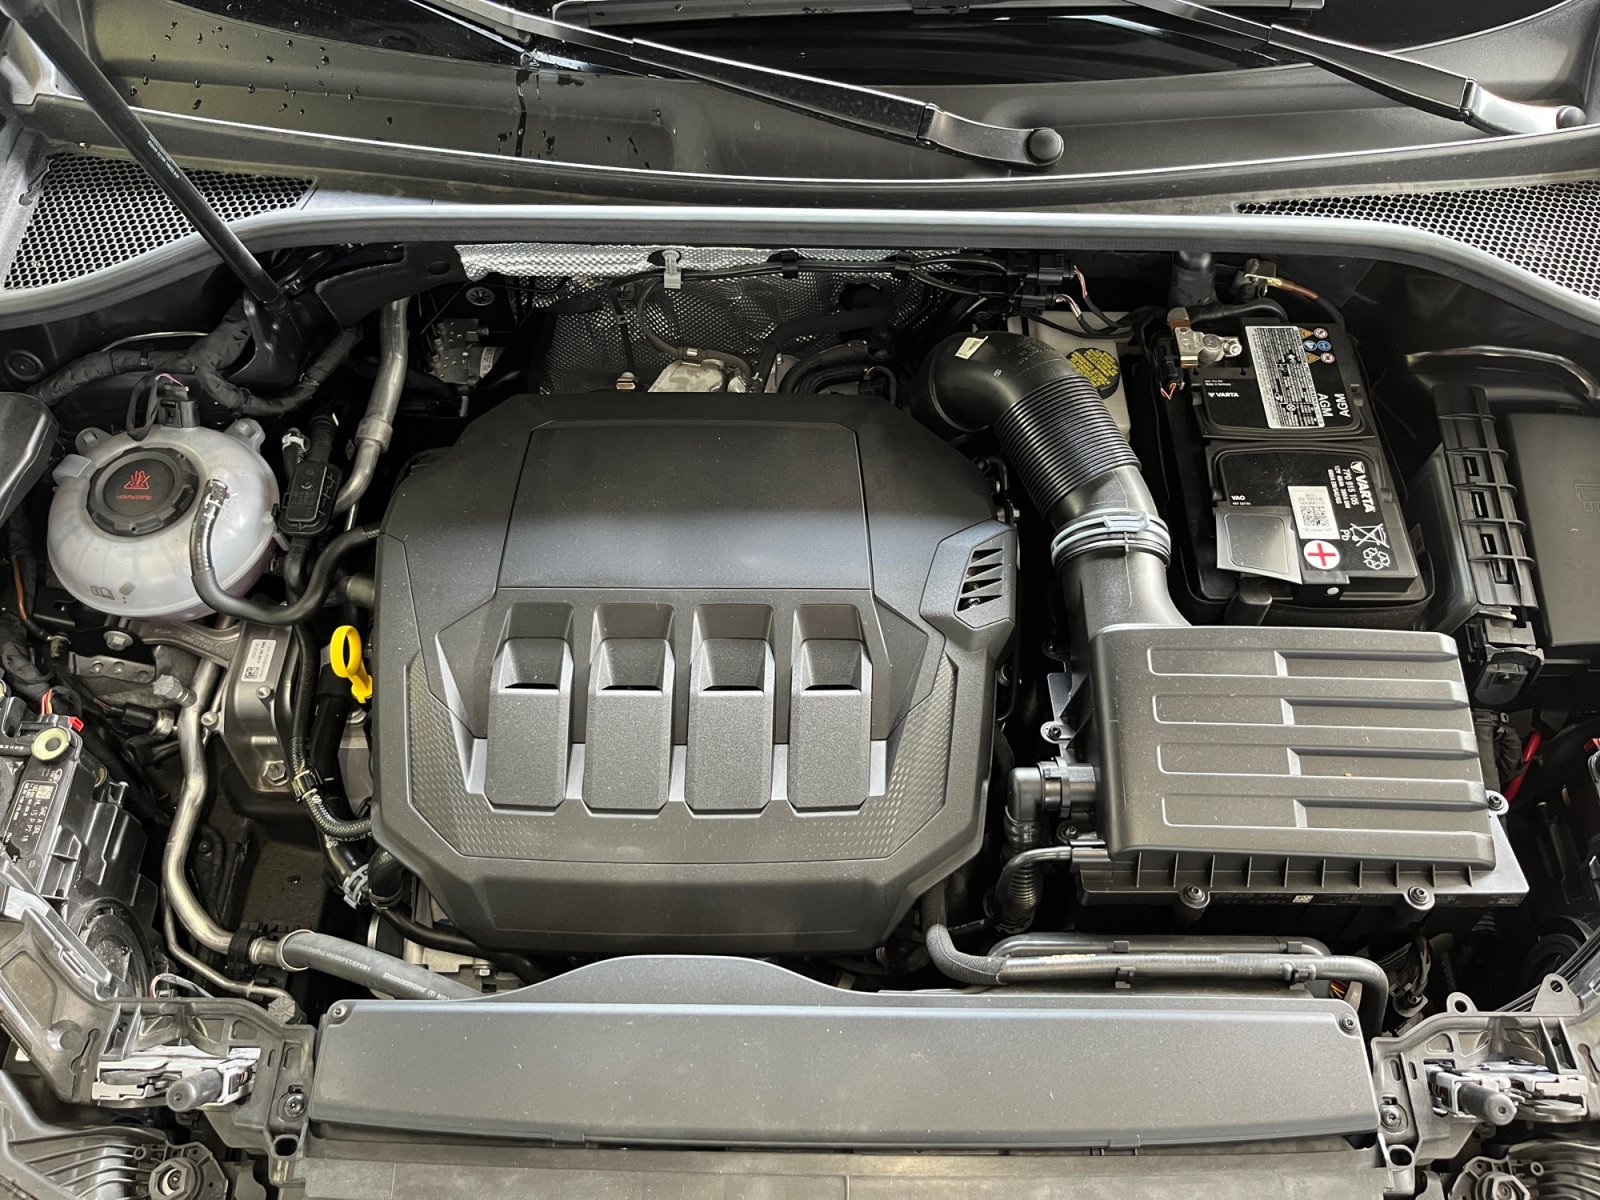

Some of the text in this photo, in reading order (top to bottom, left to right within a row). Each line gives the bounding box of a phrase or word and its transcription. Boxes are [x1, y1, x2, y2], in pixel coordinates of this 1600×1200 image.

[1317, 392, 1334, 417] AGM
[1334, 393, 1352, 418] AGM
[1345, 480, 1356, 493] 915
[1355, 474, 1376, 513] VARTA
[1340, 529, 1351, 541] Pb
[382, 972, 427, 993] BRIDGESTONE
